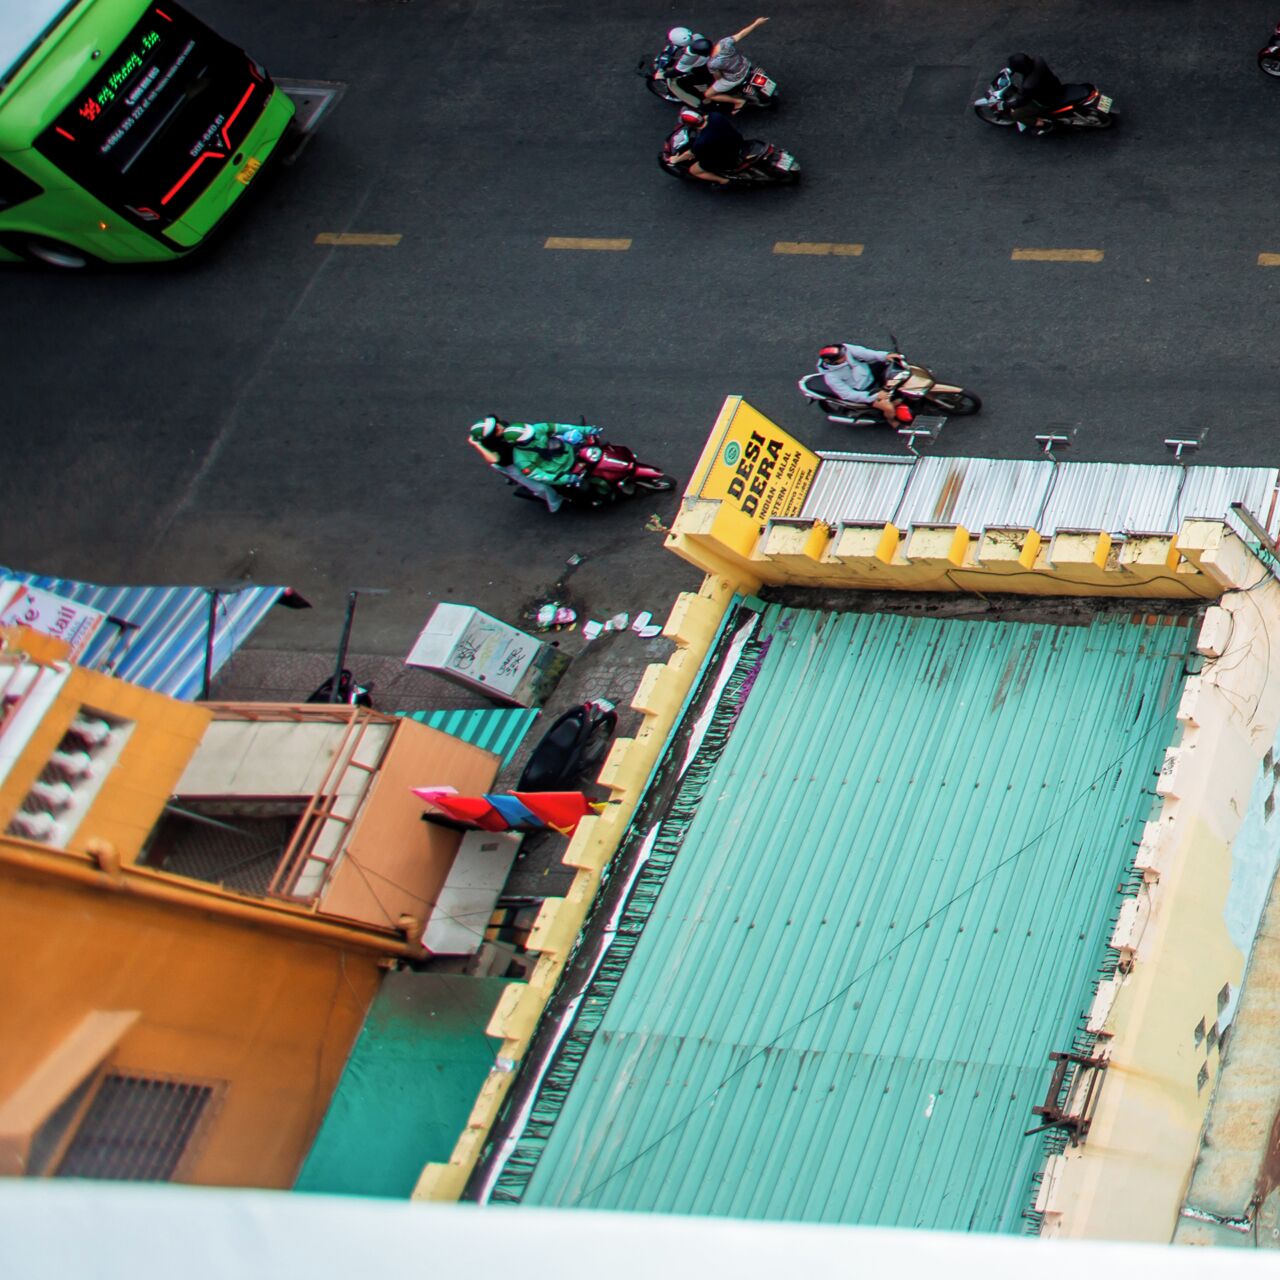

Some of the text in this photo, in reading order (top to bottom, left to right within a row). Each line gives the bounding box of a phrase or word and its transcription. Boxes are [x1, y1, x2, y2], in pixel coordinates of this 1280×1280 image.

[726, 430, 767, 501] DESI
[740, 438, 784, 518] DERA
[759, 488, 777, 520] INDIAN
[777, 452, 792, 480] HALAL
[772, 488, 789, 517] STERN
[788, 451, 802, 480] ASIAN
